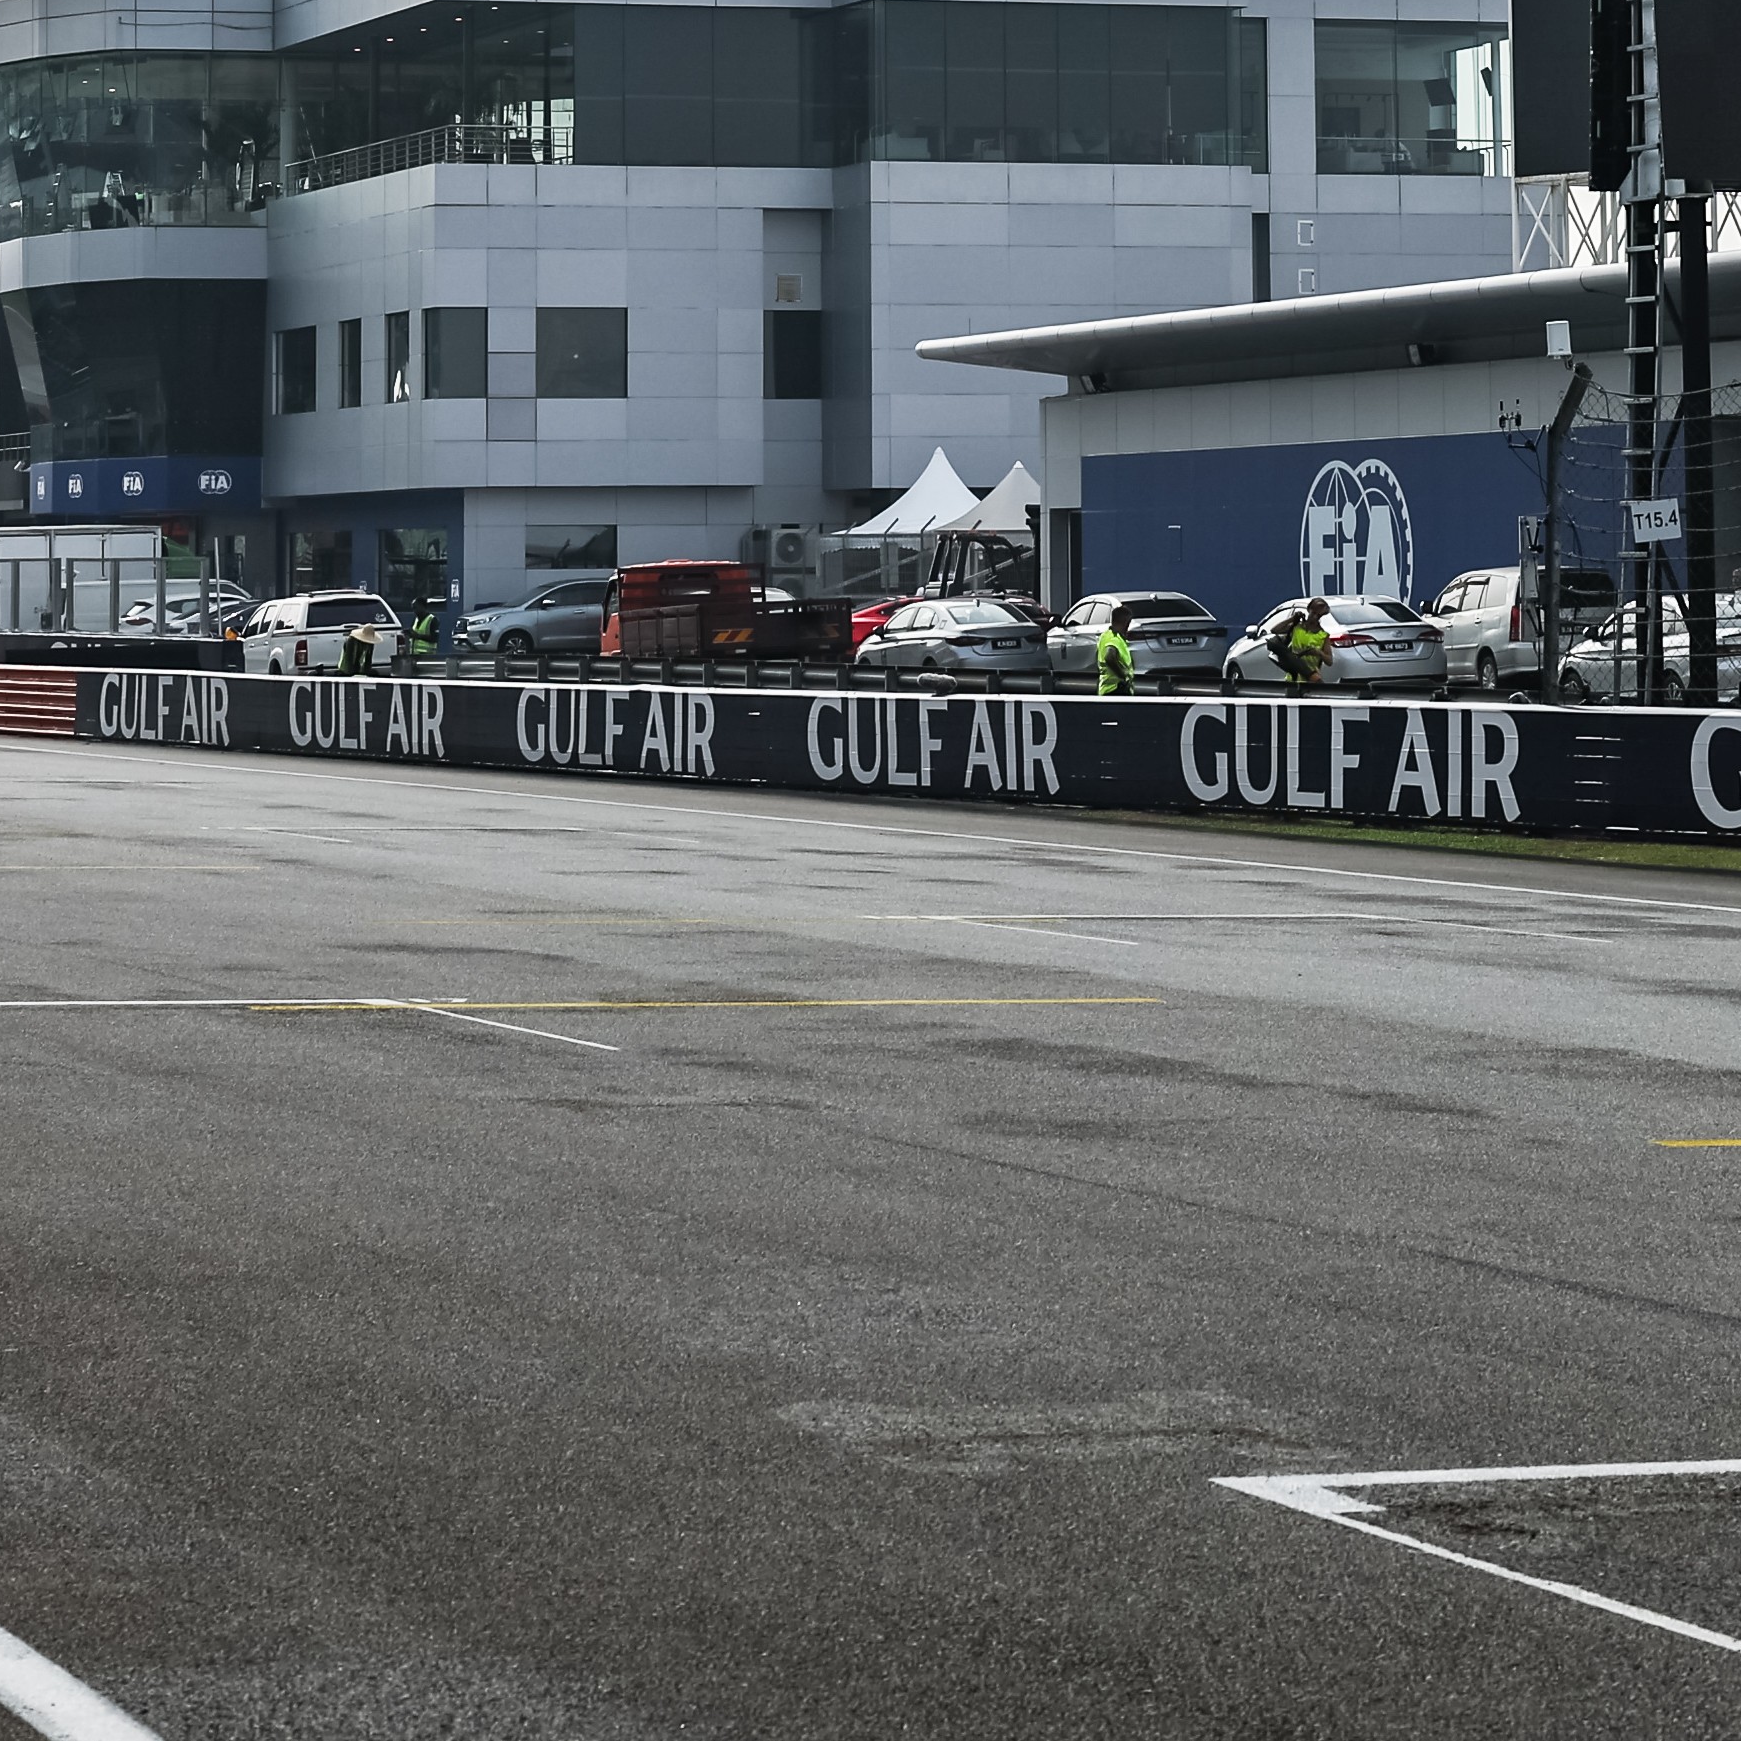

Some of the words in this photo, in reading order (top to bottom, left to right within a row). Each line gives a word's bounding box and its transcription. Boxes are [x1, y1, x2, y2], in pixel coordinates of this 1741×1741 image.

[1633, 508, 1678, 530] T15.4
[99, 673, 174, 739] GULF
[180, 674, 230, 747] AIR
[288, 681, 376, 750] GULF
[385, 684, 445, 758] AIR
[517, 687, 630, 764] GULF
[639, 690, 715, 776] AIR
[807, 697, 947, 788] GULF
[964, 700, 1060, 795] AIR
[1180, 703, 1369, 809] GULF
[1388, 705, 1521, 822] AIR
